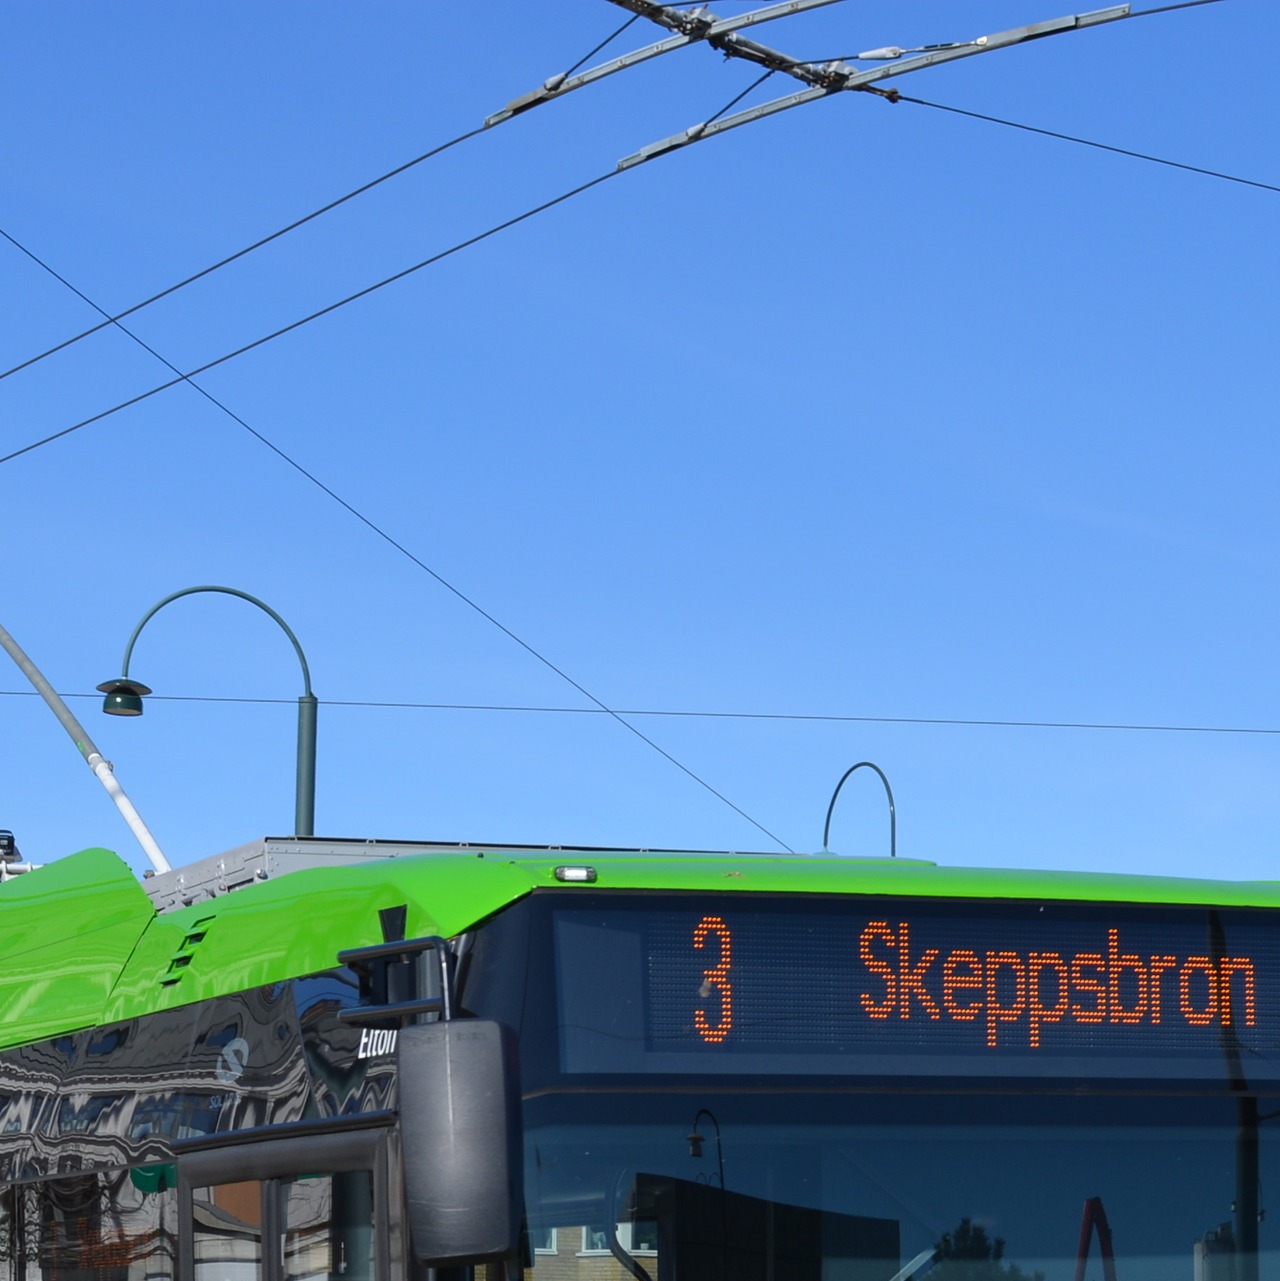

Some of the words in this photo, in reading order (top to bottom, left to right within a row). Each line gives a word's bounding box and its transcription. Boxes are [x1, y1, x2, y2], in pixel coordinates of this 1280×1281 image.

[693, 916, 732, 1042] 3
[859, 920, 1257, 1048] Skeppsbron
[357, 1028, 398, 1060] Elton
